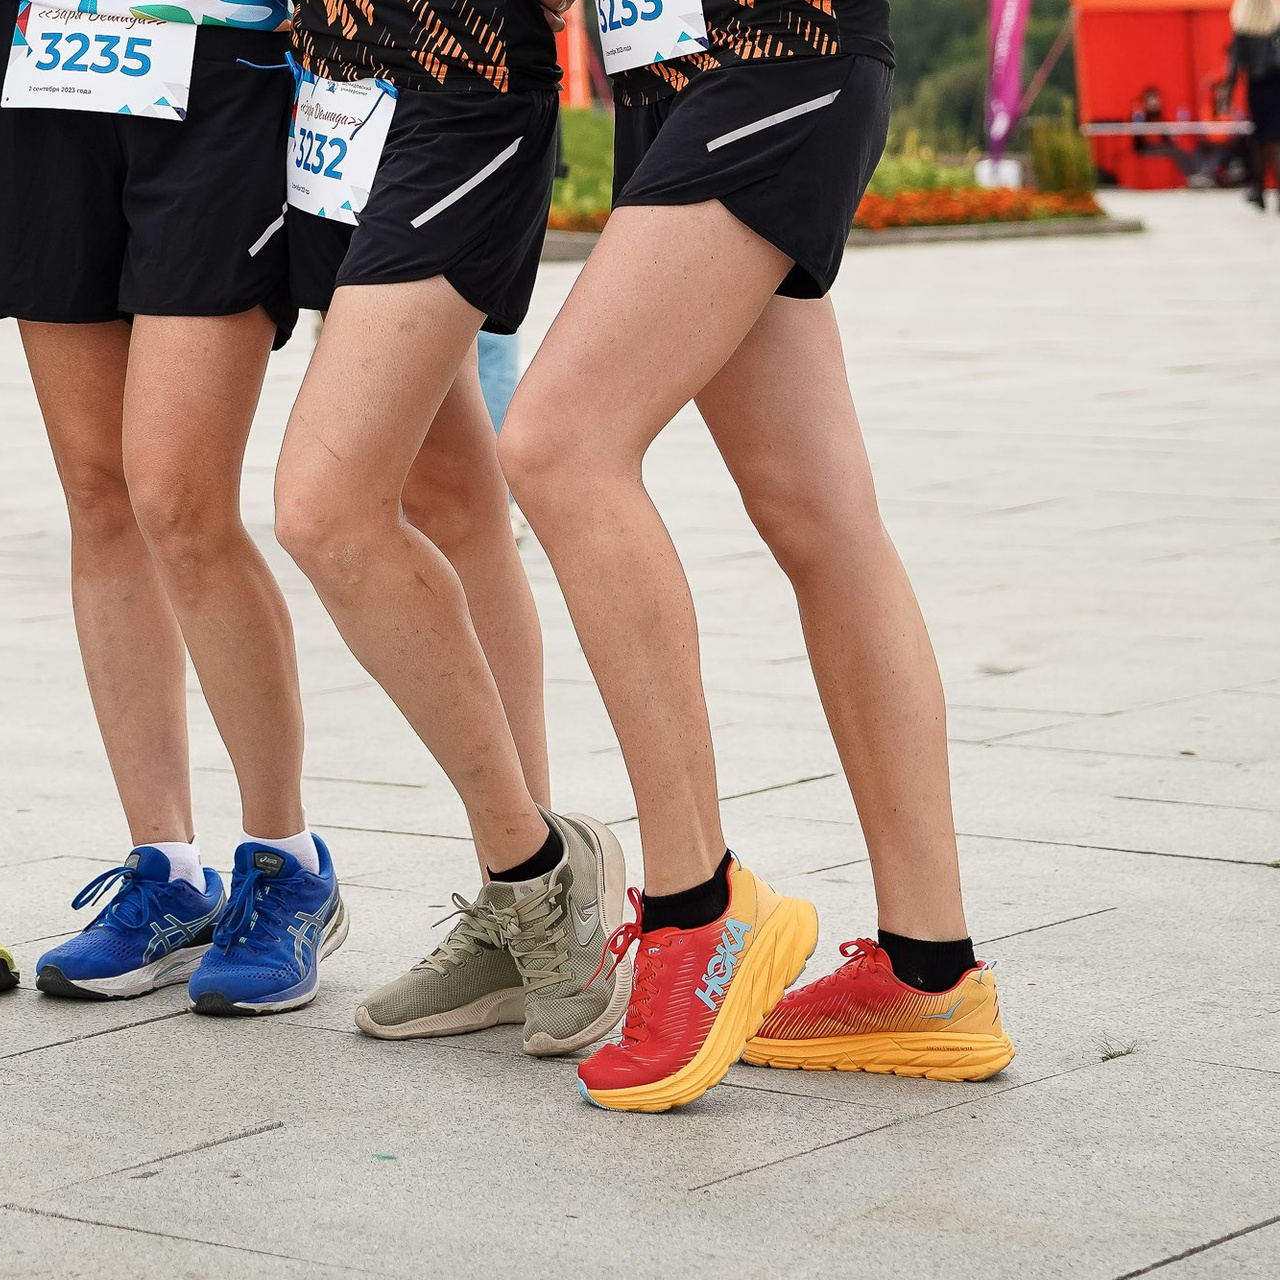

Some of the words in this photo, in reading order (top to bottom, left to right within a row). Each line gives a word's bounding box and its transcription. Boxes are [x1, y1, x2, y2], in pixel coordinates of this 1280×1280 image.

[35, 32, 152, 77] 3235
[61, 86, 76, 94] 2023
[295, 128, 348, 181] 3232
[694, 917, 752, 1011] HOKA
